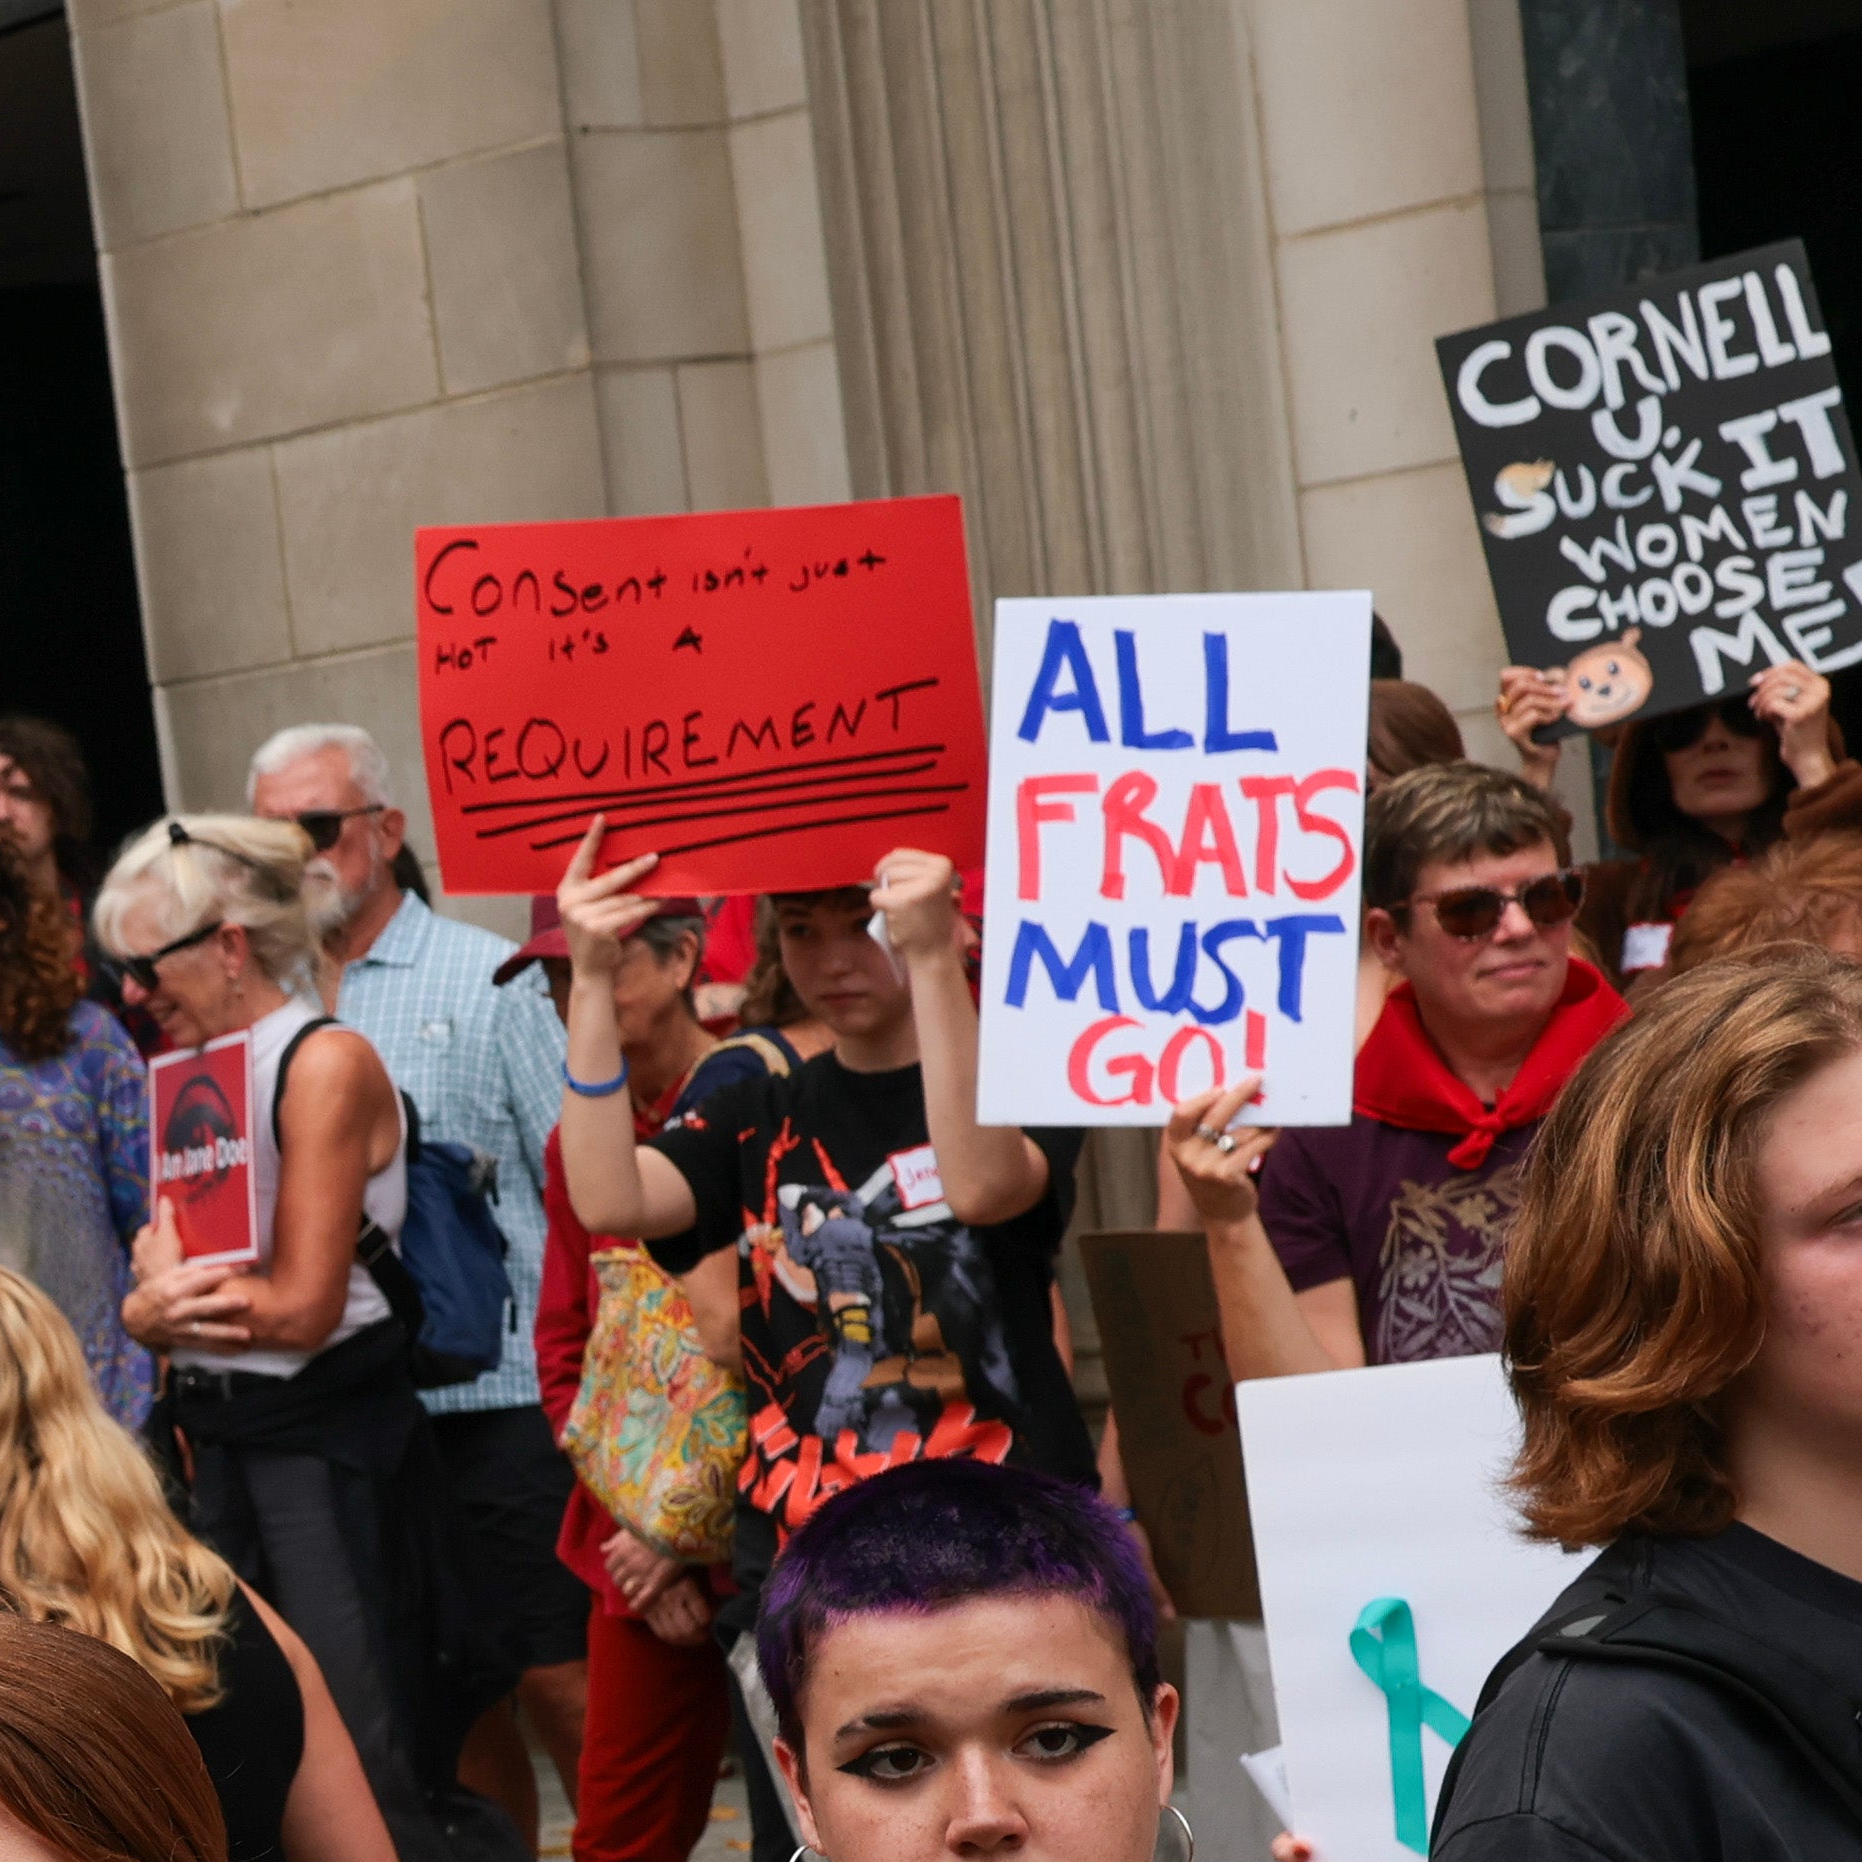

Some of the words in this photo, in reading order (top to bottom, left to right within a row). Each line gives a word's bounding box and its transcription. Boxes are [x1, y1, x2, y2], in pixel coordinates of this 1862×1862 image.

[1457, 263, 1831, 428] CORNELL
[1484, 437, 1722, 539] SUCK
[1719, 387, 1847, 491] IT
[424, 541, 668, 617] Consent
[693, 547, 768, 593] isn't
[789, 549, 886, 592] just
[1560, 490, 1848, 584] WOMEN
[1546, 548, 1835, 642] CHOOSE
[440, 678, 939, 794] REQUIREMENT
[1017, 618, 1278, 753] ALL
[1016, 767, 1360, 900] FRATS
[1004, 914, 1346, 1025] MUST
[1067, 1008, 1266, 1108] GO!
